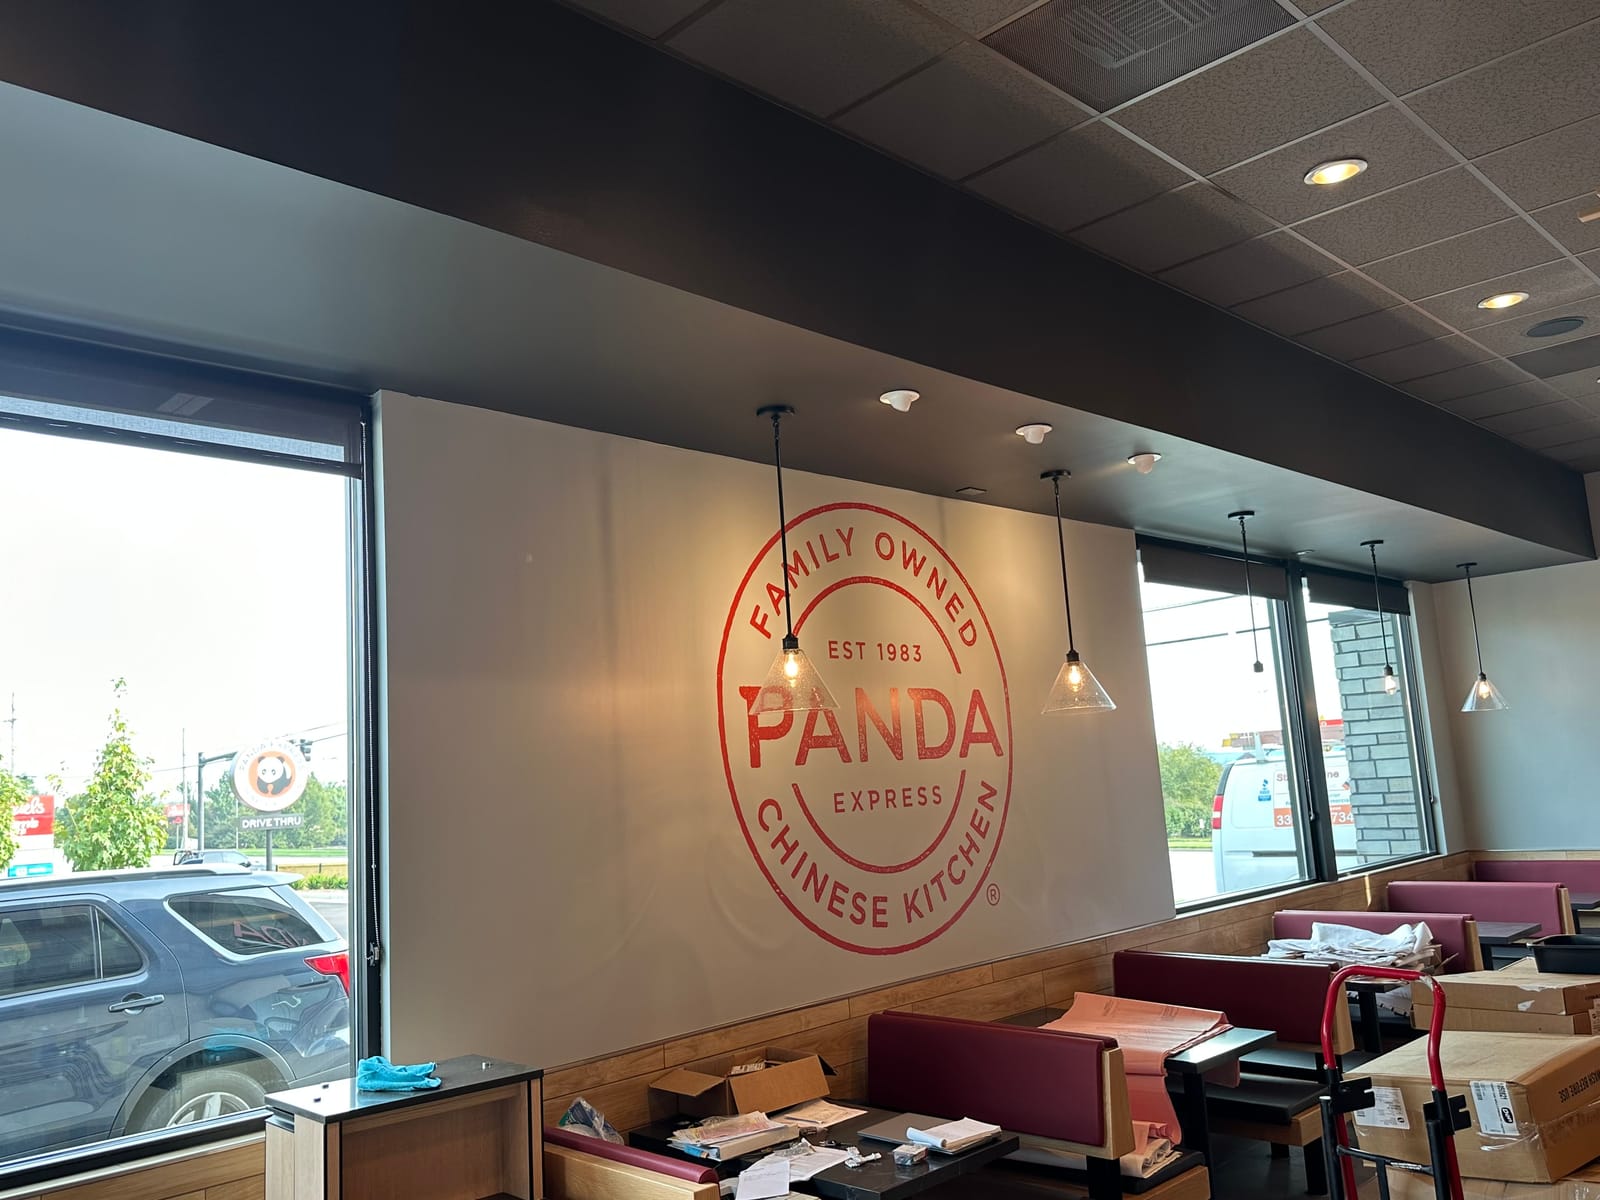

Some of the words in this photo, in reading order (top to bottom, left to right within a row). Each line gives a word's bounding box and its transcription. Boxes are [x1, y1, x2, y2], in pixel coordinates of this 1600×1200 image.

[750, 526, 855, 639] FAMILY
[875, 532, 977, 647] OWNED
[828, 640, 866, 660] EST
[877, 642, 922, 662] 1983
[738, 685, 1004, 769] PANDA
[242, 819, 272, 829] DRIVE
[273, 816, 301, 827] THRU
[833, 785, 942, 813] EXPRESS
[757, 797, 889, 929] CHINESE
[903, 780, 998, 924] KITCHEN
